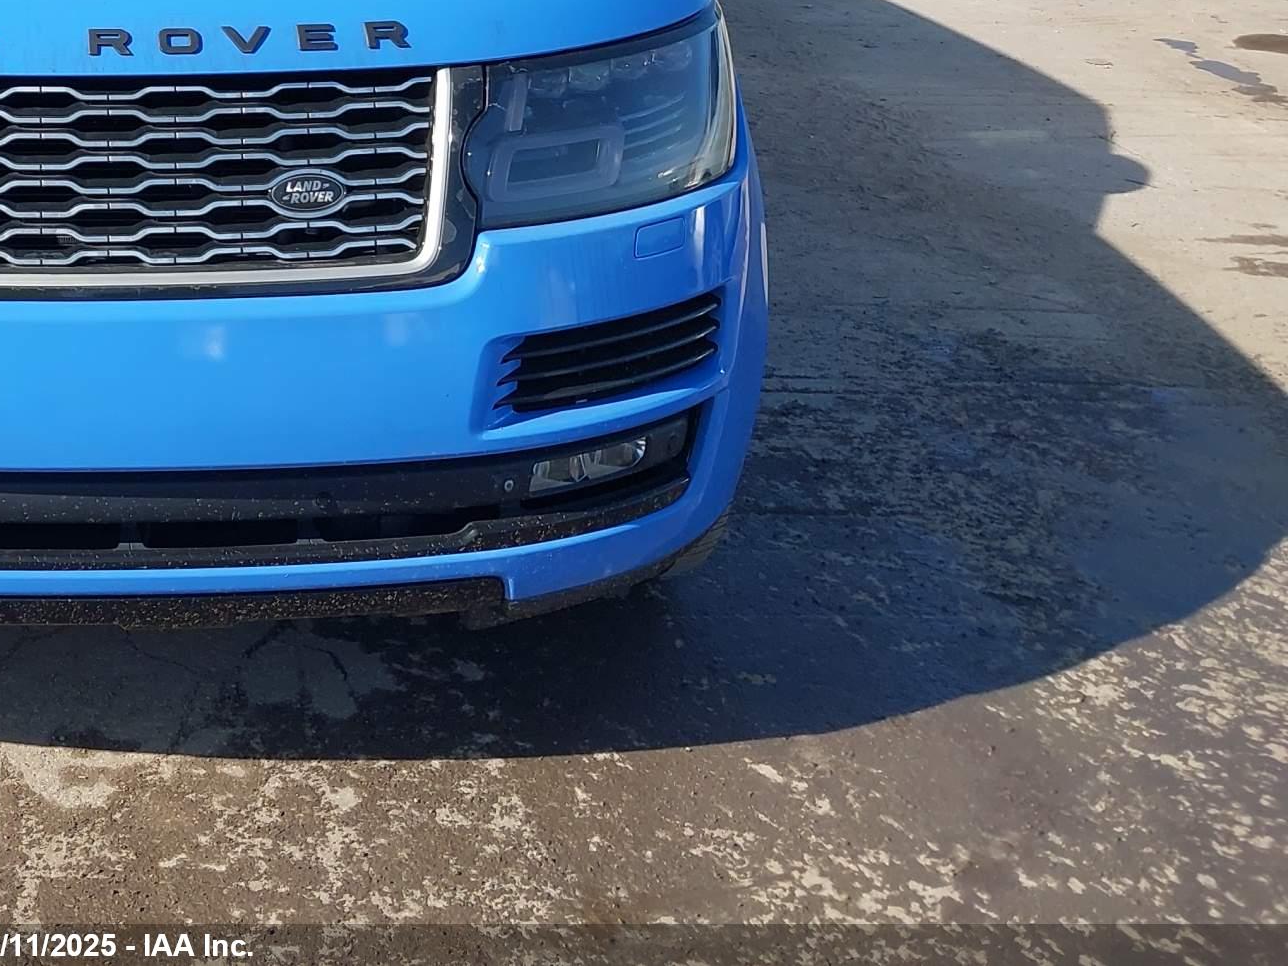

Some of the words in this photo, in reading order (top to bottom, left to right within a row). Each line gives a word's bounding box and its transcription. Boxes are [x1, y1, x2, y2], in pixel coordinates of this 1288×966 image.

[87, 20, 411, 56] ROVER
[286, 180, 321, 193] LAND
[290, 191, 334, 204] ROVER
